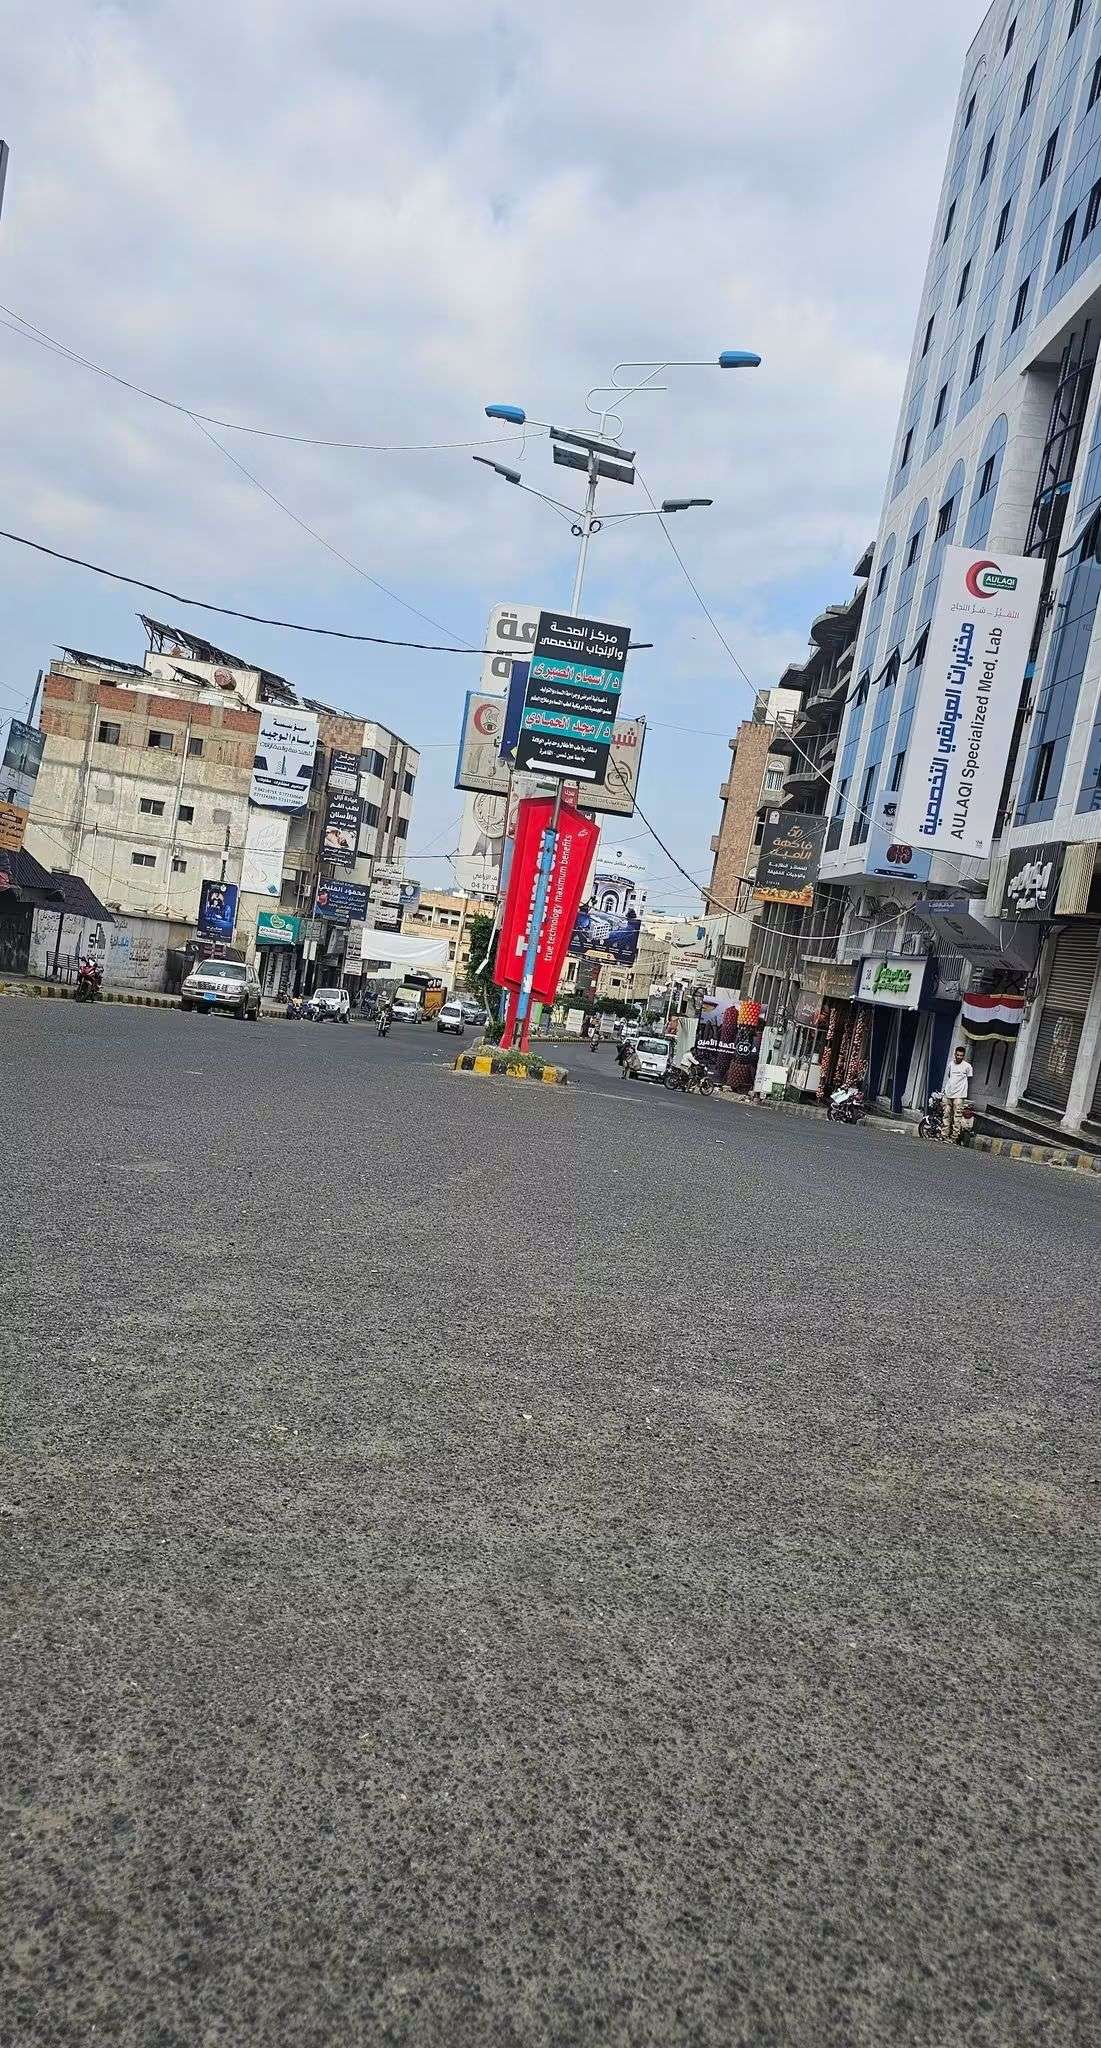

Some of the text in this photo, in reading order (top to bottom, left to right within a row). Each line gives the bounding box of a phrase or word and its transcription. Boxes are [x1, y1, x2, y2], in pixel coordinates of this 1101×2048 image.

[589, 629, 618, 644] مركز
[985, 575, 1016, 586] AULAQI
[918, 622, 976, 837] مختبرات العولقي التخصصية
[950, 626, 1003, 841] AULAQI Specialized Med. Lab
[544, 834, 573, 961] true technology maximum benefits
